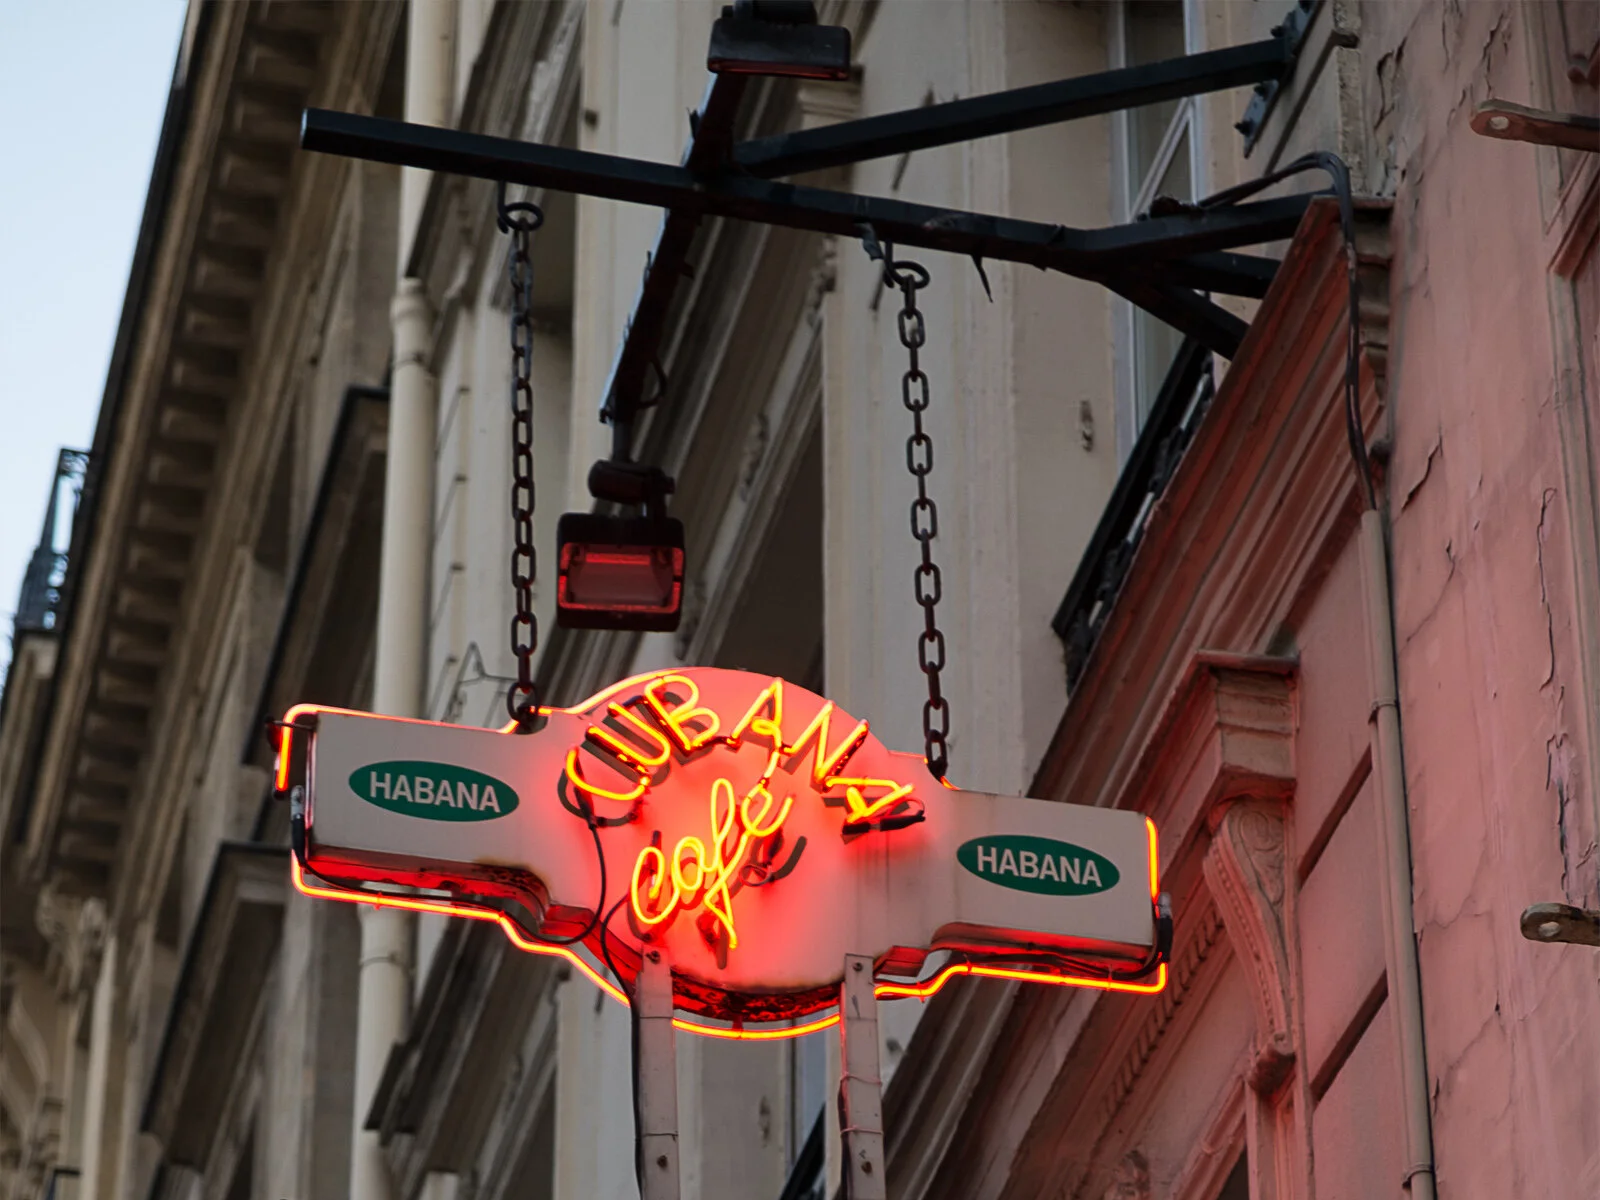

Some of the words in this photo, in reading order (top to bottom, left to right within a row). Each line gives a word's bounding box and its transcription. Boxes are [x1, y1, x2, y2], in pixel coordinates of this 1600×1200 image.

[565, 675, 915, 824] CUBANA
[368, 771, 502, 814] HABANA
[975, 844, 1103, 888] HABANA
